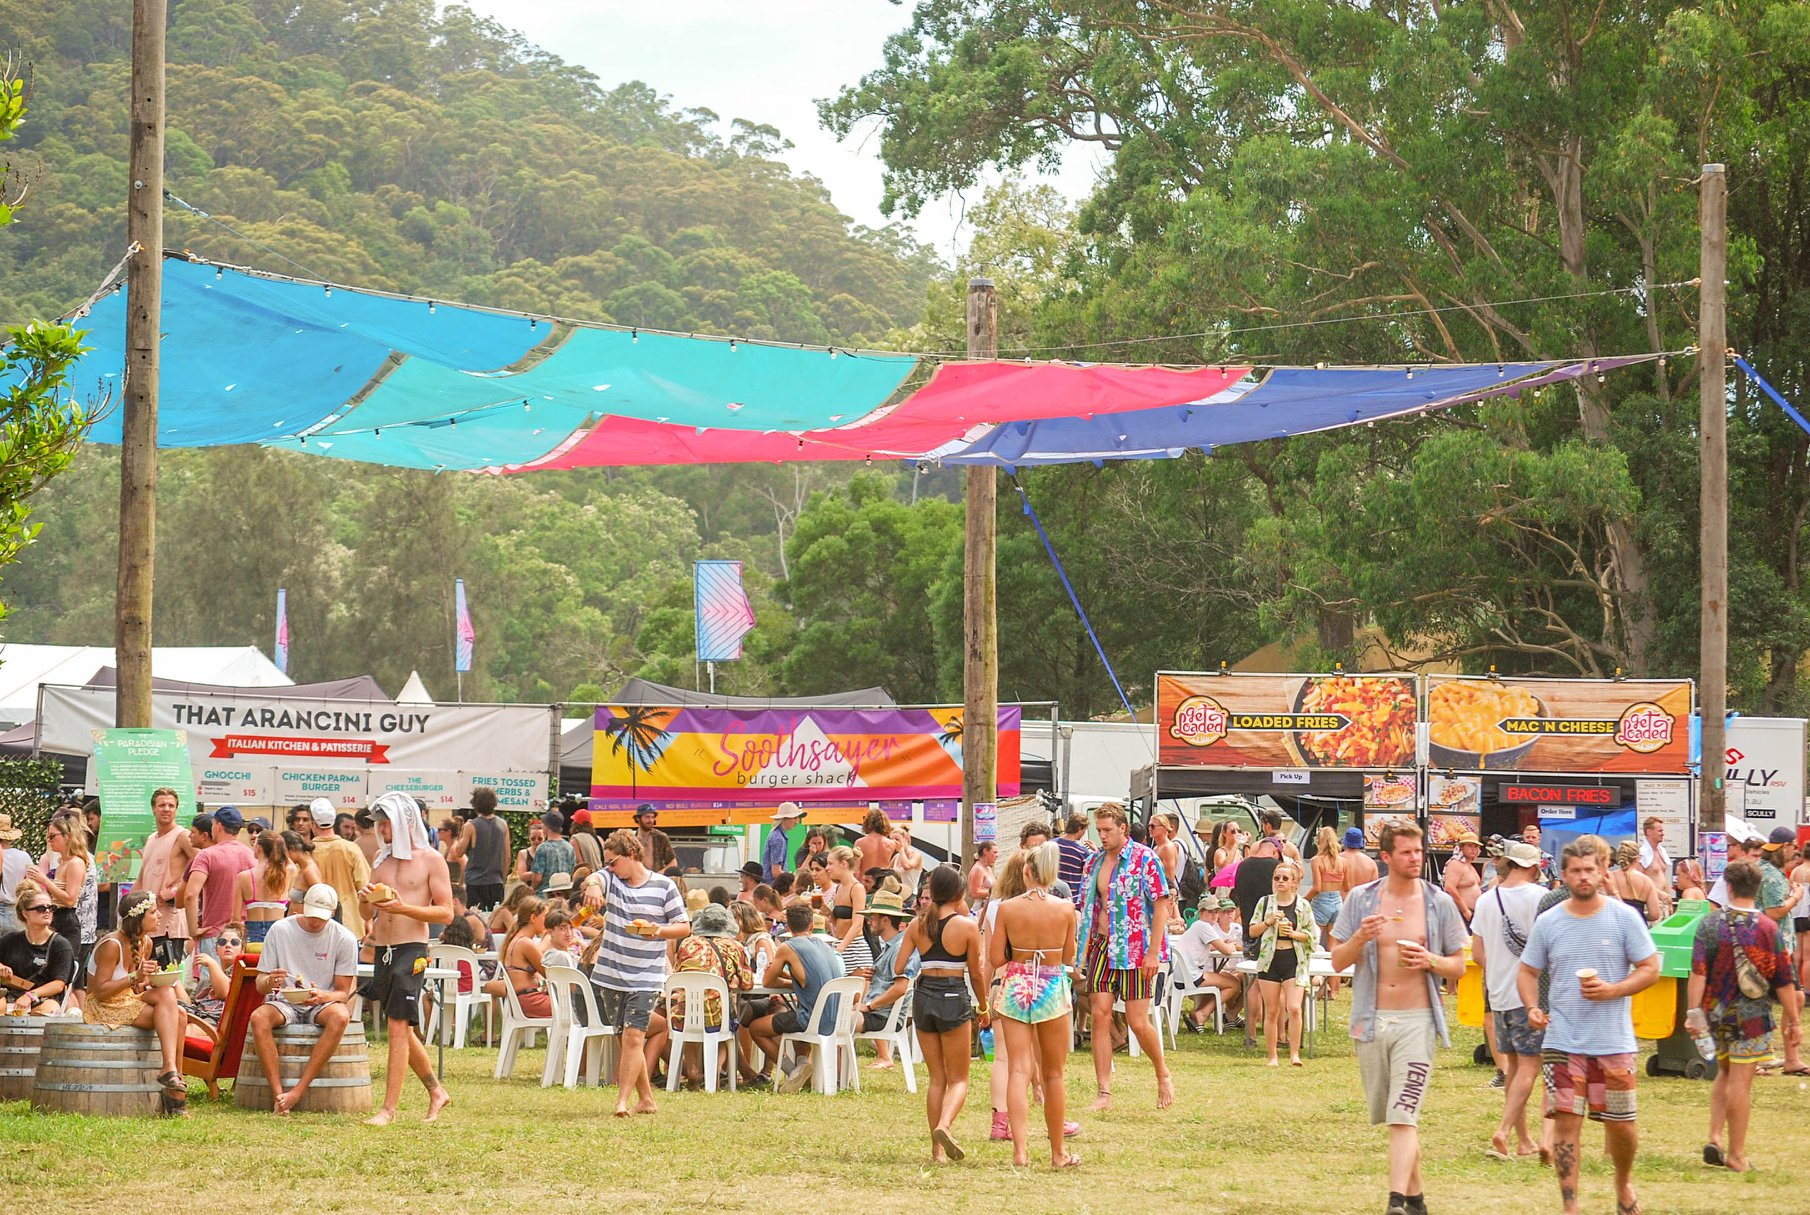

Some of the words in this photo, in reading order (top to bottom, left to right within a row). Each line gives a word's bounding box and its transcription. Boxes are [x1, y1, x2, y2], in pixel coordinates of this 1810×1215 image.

[172, 704, 236, 727] THAT
[240, 708, 372, 732] ARANCINI
[379, 713, 430, 733] GUY
[1186, 704, 1216, 723] get
[1631, 710, 1661, 729] get
[1174, 712, 1223, 736] Loaded
[1233, 716, 1293, 728] LOADED
[1296, 716, 1339, 728] FRIES
[1506, 721, 1540, 732] MAC
[1542, 722, 1556, 732] 'N
[1558, 722, 1615, 733] CHEESE
[1618, 720, 1668, 742] Loaded
[117, 740, 167, 748] PARADISIAN
[227, 738, 266, 750] ITALIAN
[267, 740, 310, 752] KITCHEN
[311, 742, 320, 752] &
[320, 742, 372, 754] PATISSERIE
[128, 748, 160, 756] PLEDGE
[713, 716, 901, 787] Soothsayer
[204, 770, 252, 780] GNOCCHI
[282, 772, 327, 782] CHICKEN
[327, 774, 360, 783] PARMA
[737, 771, 797, 788] burger
[806, 771, 854, 785] shack
[302, 783, 340, 792] BURGER
[386, 784, 444, 792] CHEESEBURGER
[472, 776, 498, 786] FRIES
[502, 778, 536, 788] TOSSED
[243, 789, 256, 798] $15
[524, 789, 530, 797] &
[1507, 787, 1562, 801] BACON
[1567, 788, 1611, 803] FRIES
[342, 796, 356, 804] $14
[440, 796, 453, 804] $14
[497, 796, 529, 806] MESAN
[1392, 1062, 1430, 1114] VENICE
